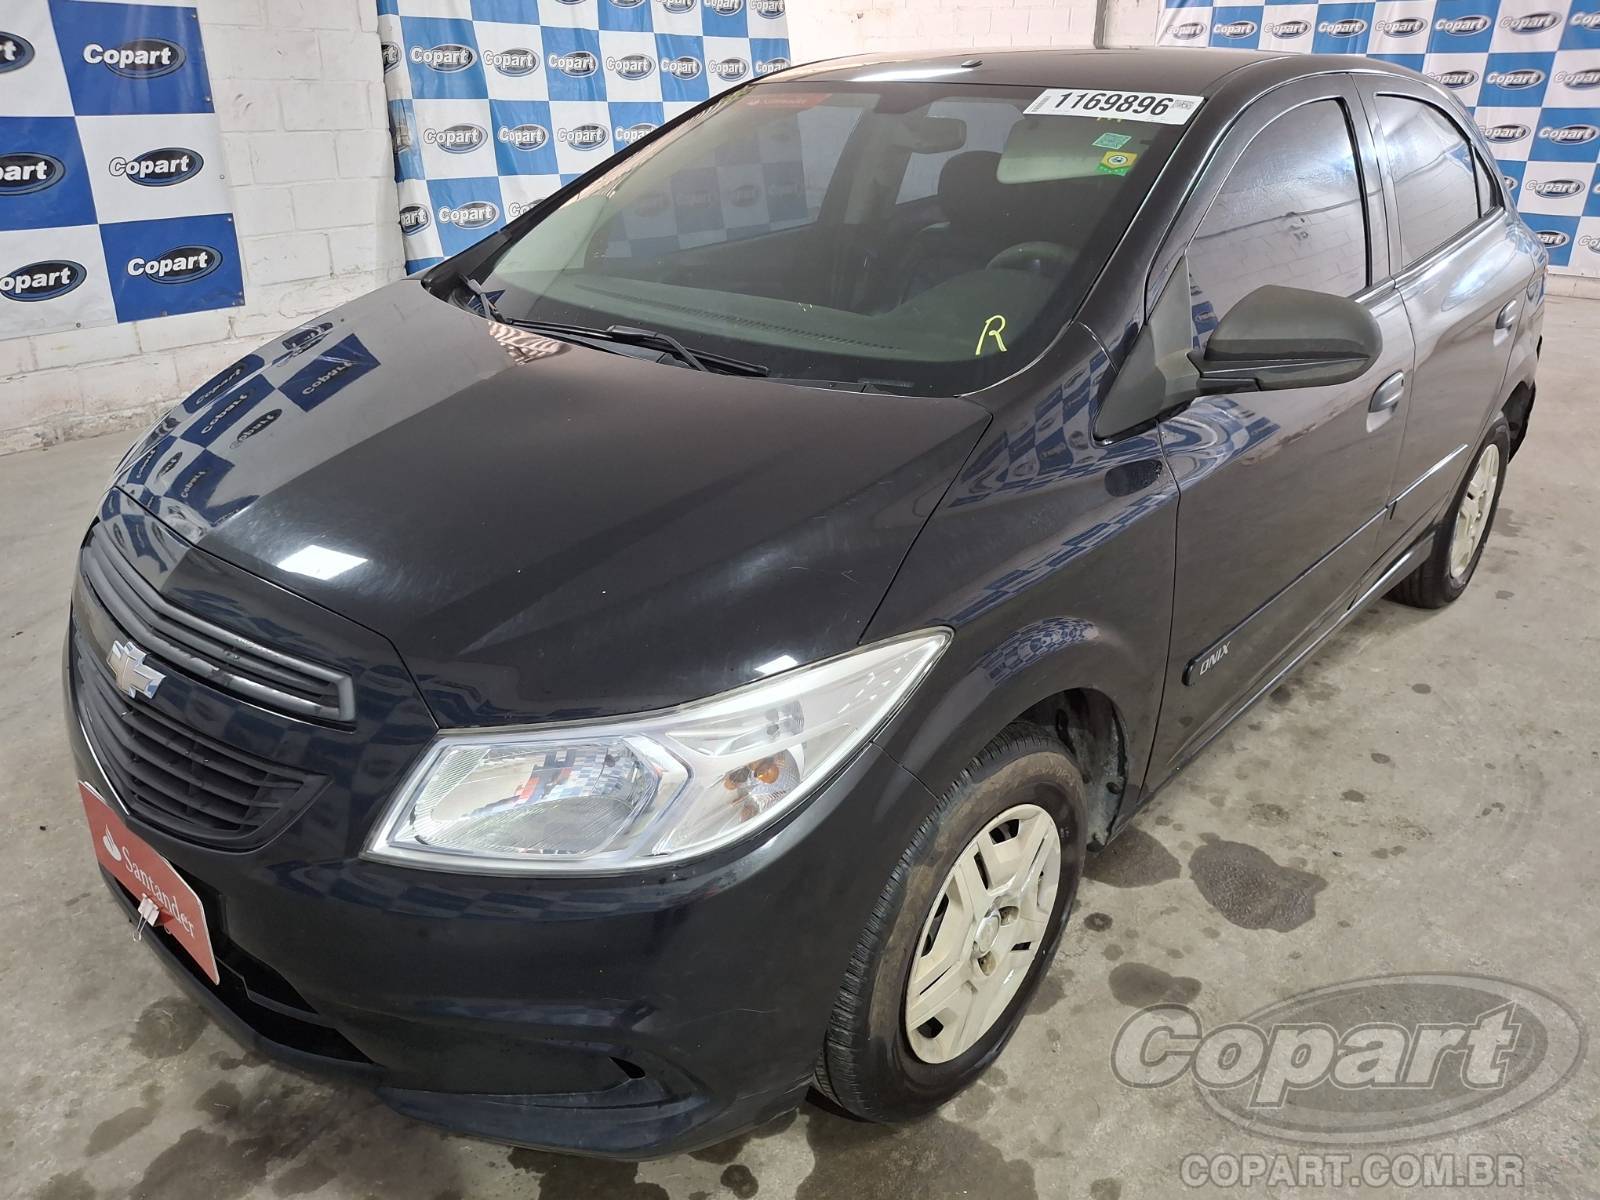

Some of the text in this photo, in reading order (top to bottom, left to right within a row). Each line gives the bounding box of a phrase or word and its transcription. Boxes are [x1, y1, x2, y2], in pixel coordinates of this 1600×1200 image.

[1214, 23, 1252, 35] Copart
[1318, 22, 1361, 35] Copart
[1376, 19, 1420, 33] Copart
[1435, 17, 1484, 32] Copart
[1501, 13, 1551, 29] Copart
[1167, 24, 1201, 36] Copart
[1264, 24, 1305, 36] Copart
[83, 43, 171, 68] Copart
[410, 47, 469, 65] Copart
[483, 50, 533, 68] Copart
[548, 54, 594, 70] Copart
[606, 57, 650, 72] Copart
[661, 59, 698, 74] Copart
[709, 60, 745, 75] Copart
[1487, 71, 1536, 86] Copart
[1554, 71, 1600, 85] Copar
[1055, 92, 1173, 115] 1169896
[424, 128, 480, 147] Copart
[499, 126, 543, 144] Copart
[557, 127, 602, 145] Copart
[1538, 126, 1591, 140] Copart
[0, 161, 47, 181] art
[109, 154, 190, 179] Copart
[1526, 180, 1577, 194] Copart
[439, 207, 493, 224] Copart
[127, 251, 208, 276] Copart
[0, 266, 71, 293] opart
[976, 315, 1007, 355] R
[1199, 641, 1231, 675] ONIX
[122, 846, 195, 938] Santander
